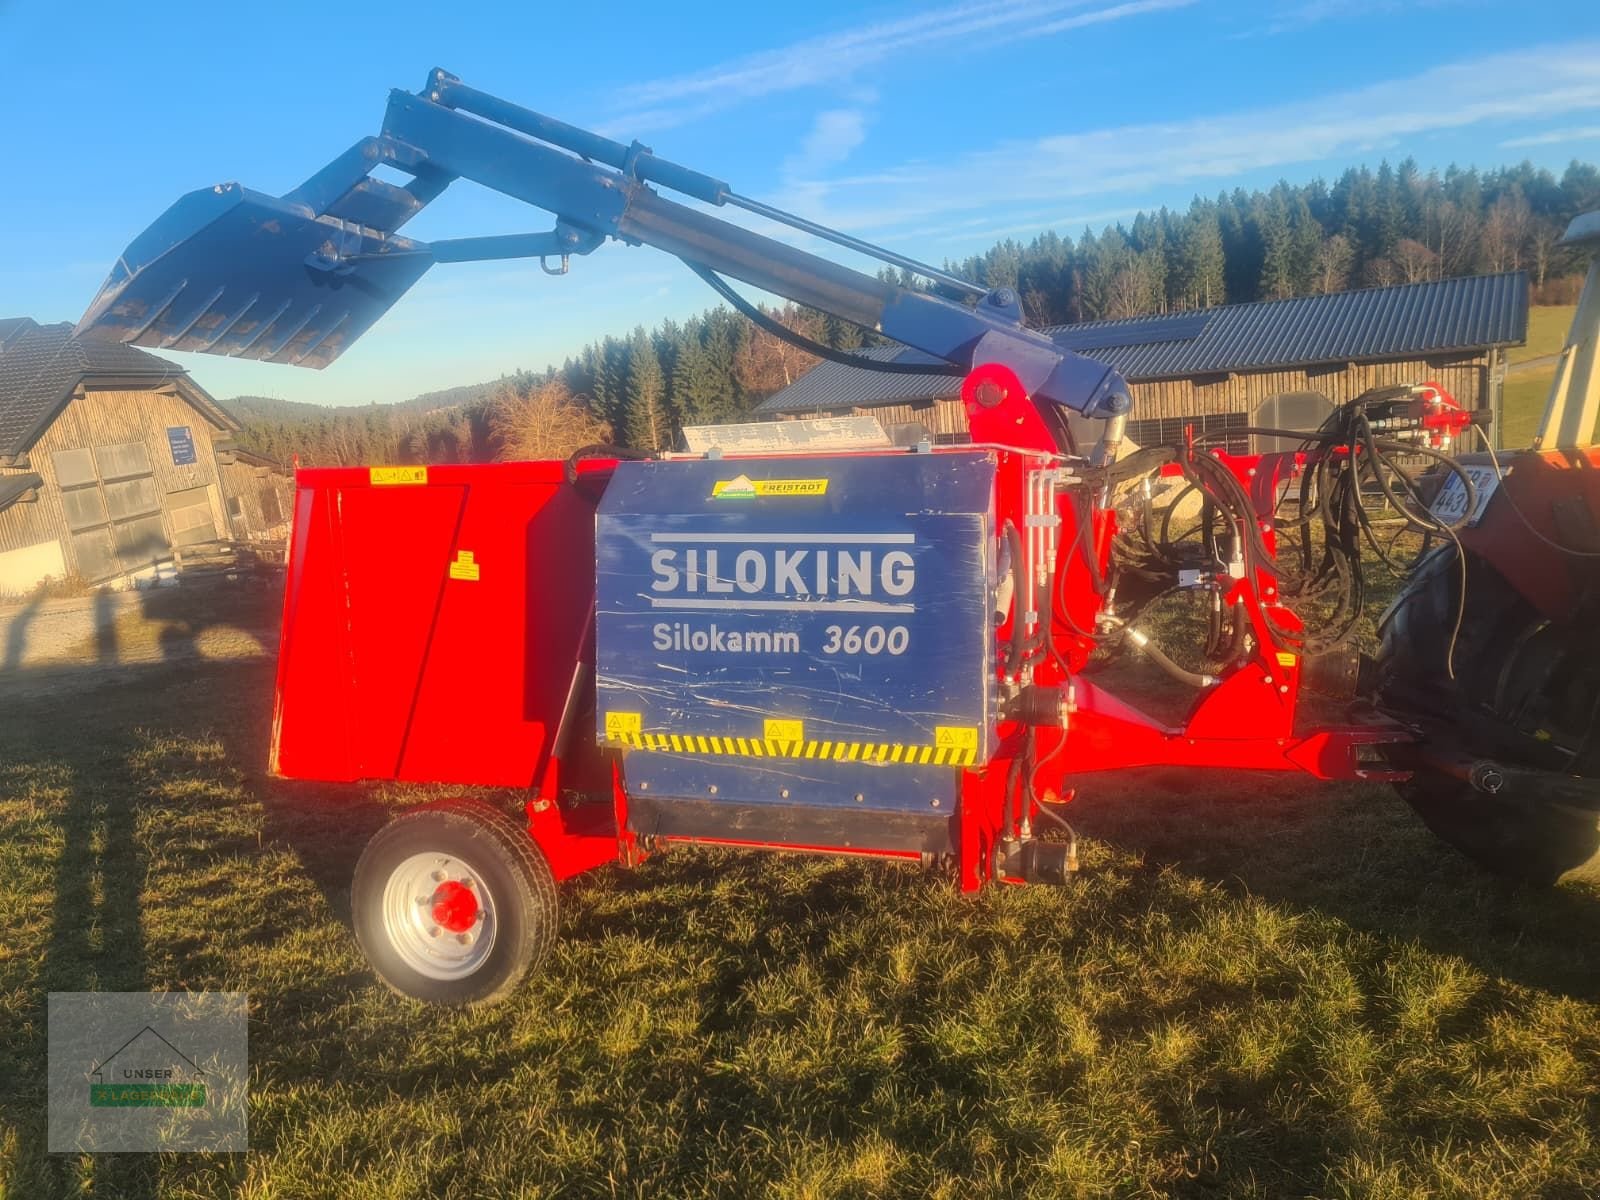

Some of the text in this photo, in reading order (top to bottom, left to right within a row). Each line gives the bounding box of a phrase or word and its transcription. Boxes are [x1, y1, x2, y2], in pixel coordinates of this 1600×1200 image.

[762, 483, 823, 492] FREISTADT
[651, 550, 915, 595] SILOKING
[653, 623, 910, 655] Silokamm 3600
